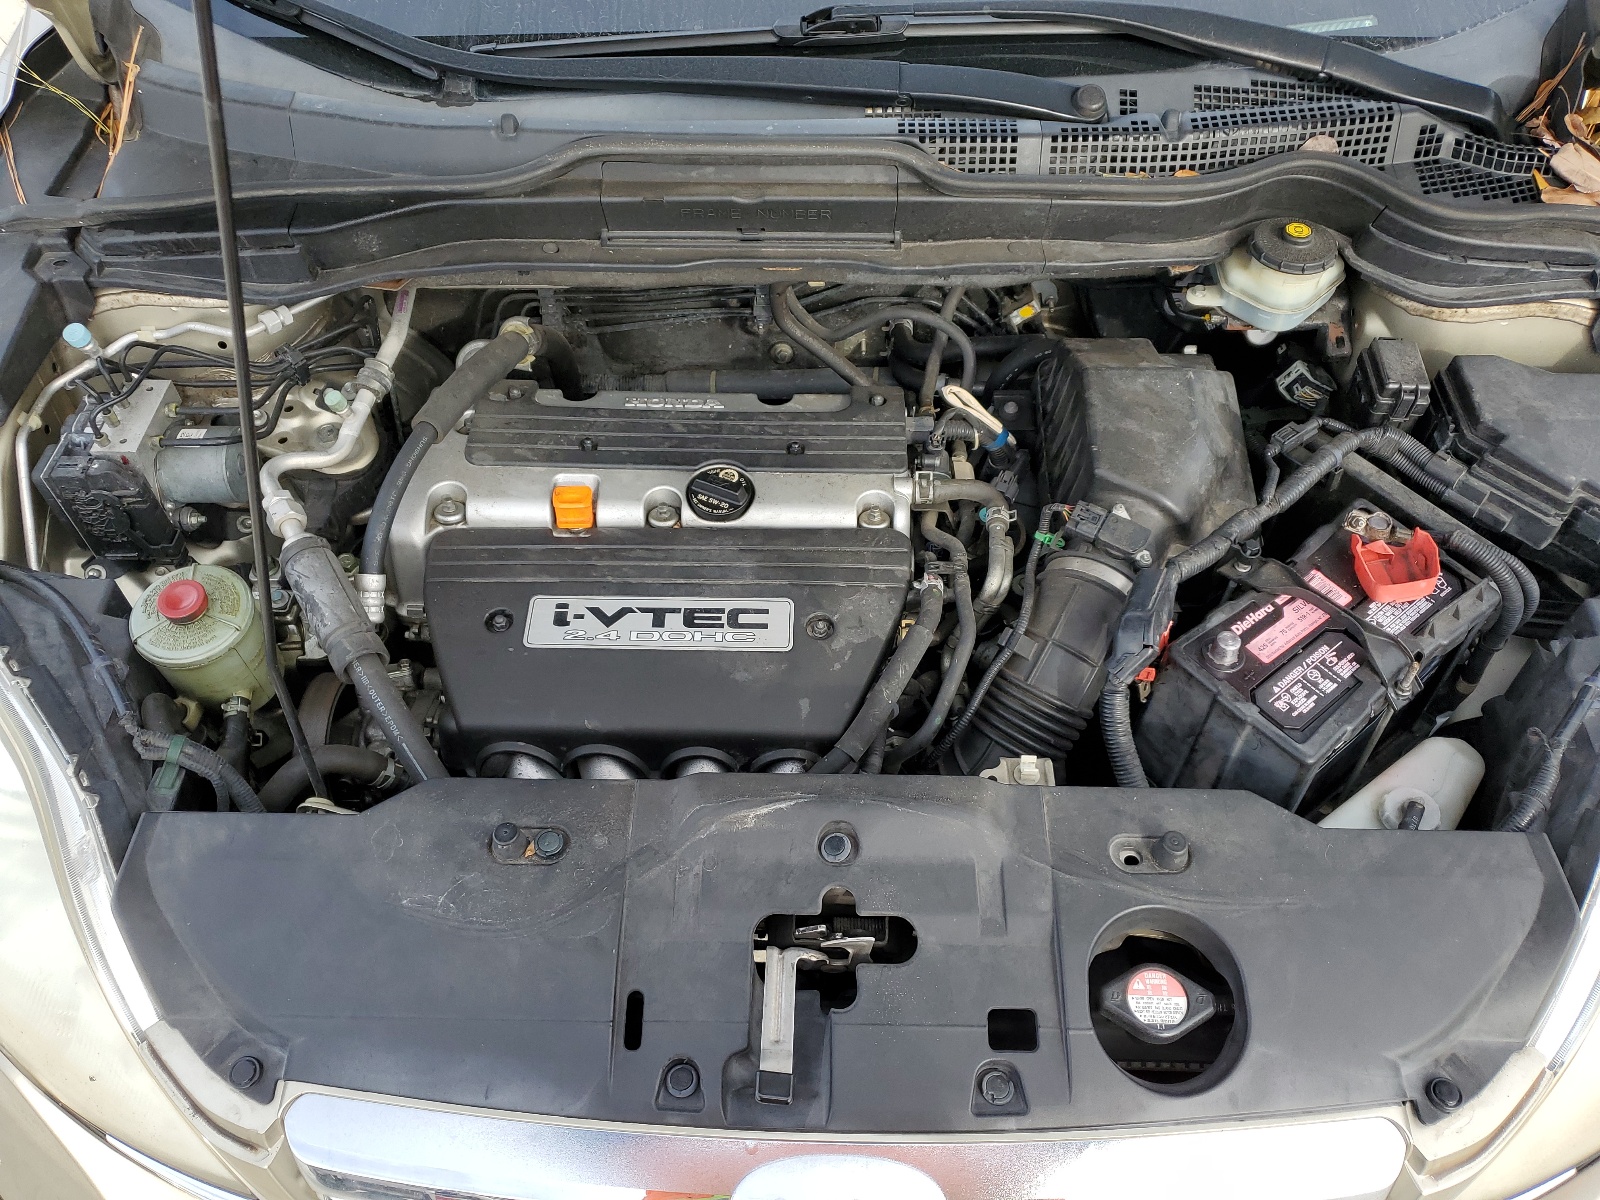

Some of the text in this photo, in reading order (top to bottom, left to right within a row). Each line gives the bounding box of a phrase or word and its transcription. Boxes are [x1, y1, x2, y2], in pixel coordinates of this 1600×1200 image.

[680, 208, 833, 220] FRAME NUMBER
[624, 397, 725, 409] HONDA
[696, 493, 709, 502] SAE
[708, 497, 729, 509] 5W-20
[552, 602, 770, 630] i-VTEC
[563, 629, 756, 643] 2.4 DOHC
[1277, 666, 1305, 689] DANGER
[1306, 644, 1330, 665] POISON
